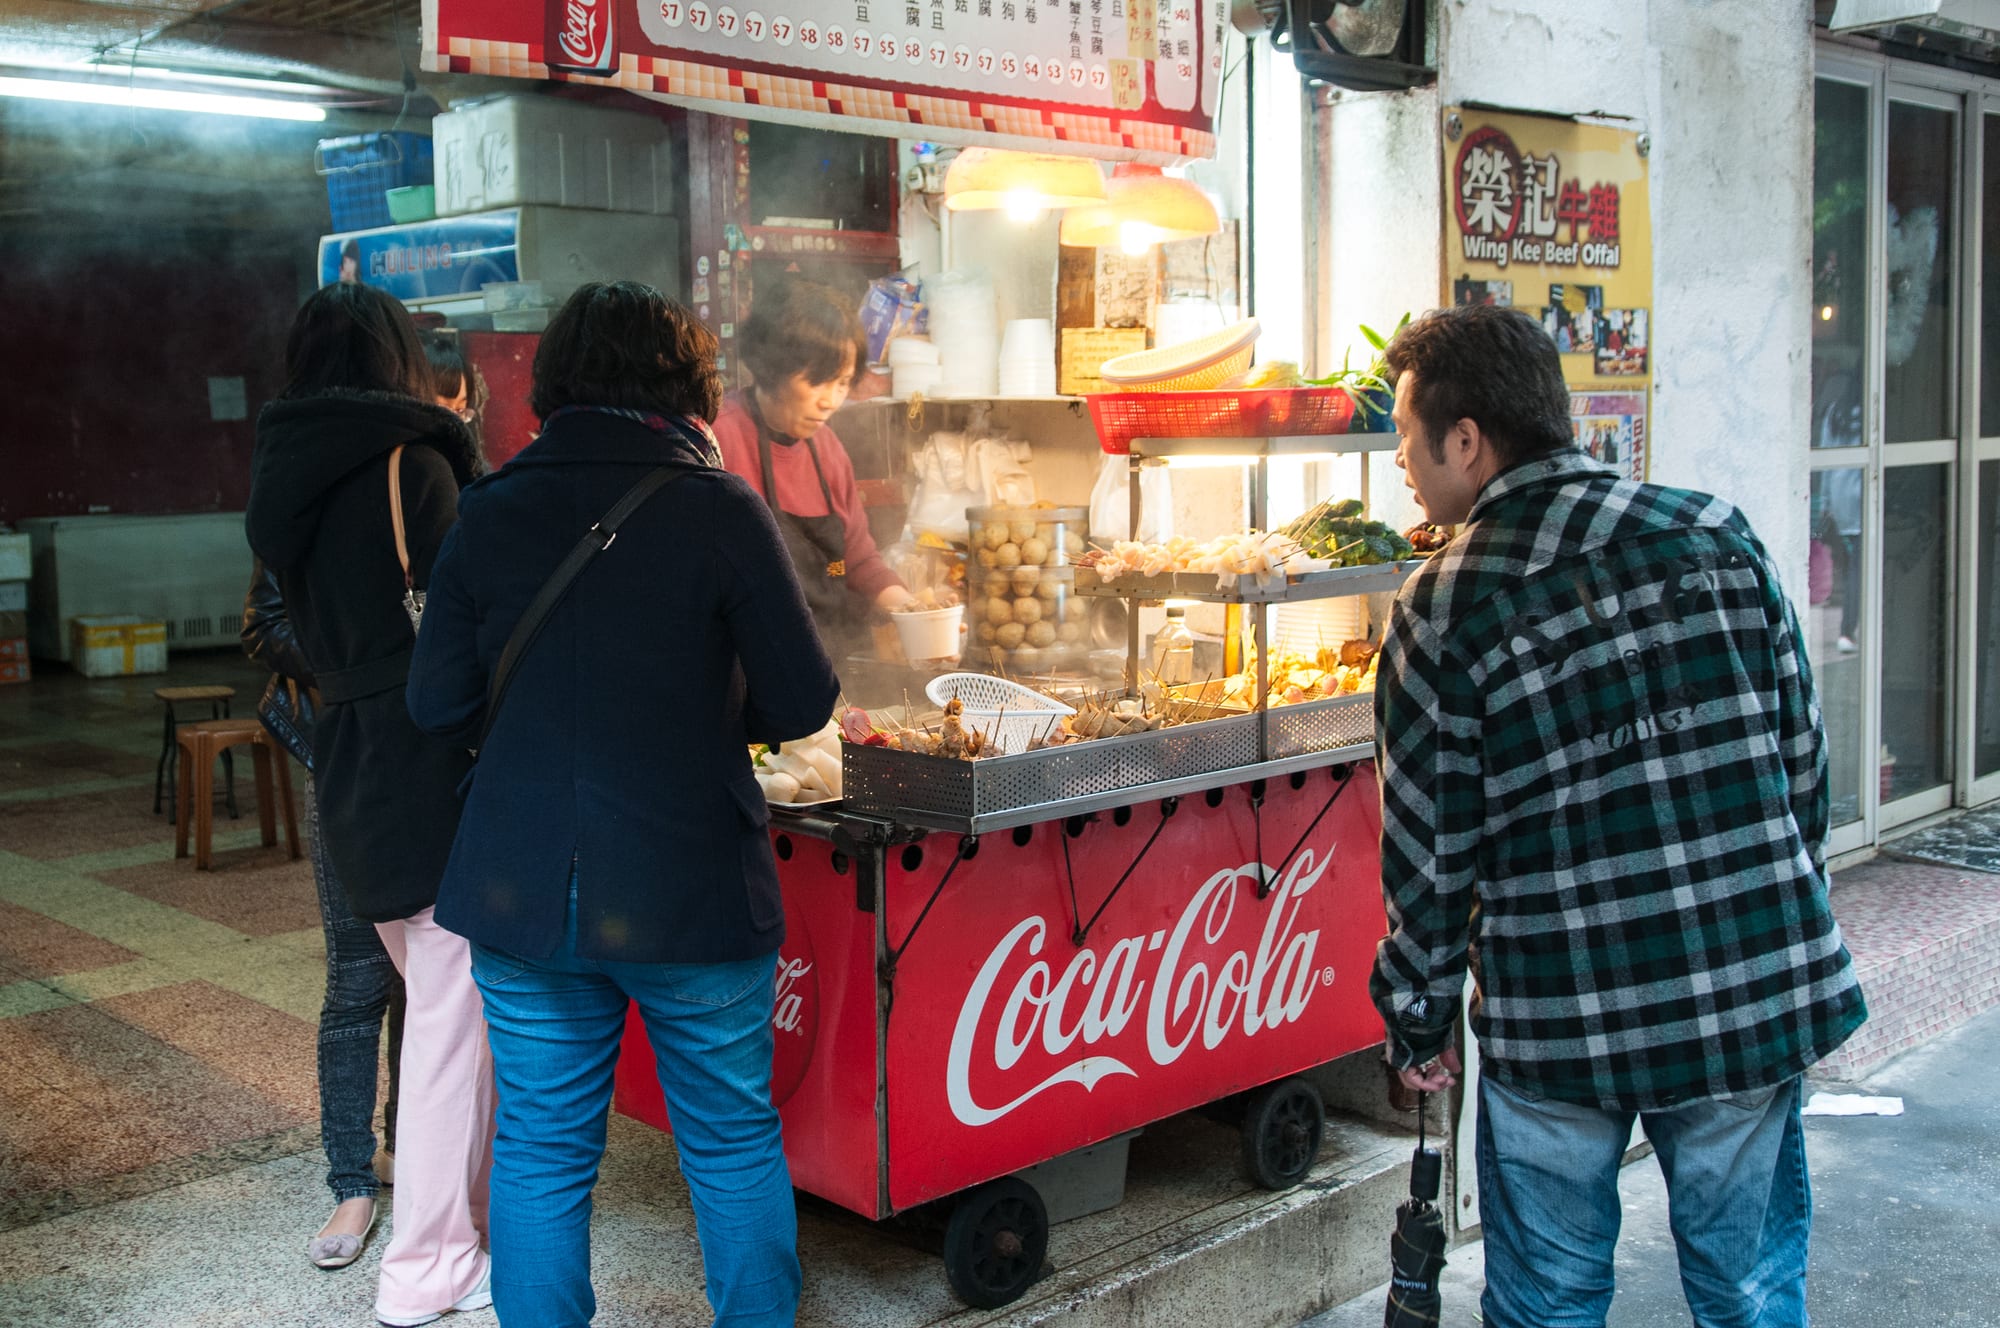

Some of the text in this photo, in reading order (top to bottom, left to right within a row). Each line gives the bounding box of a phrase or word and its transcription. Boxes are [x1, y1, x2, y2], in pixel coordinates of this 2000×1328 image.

[660, 3, 678, 20] $7
[689, 9, 706, 26] $7
[717, 13, 735, 31] $7
[745, 18, 762, 36] $7
[772, 23, 790, 40] $7
[800, 28, 817, 44] $8
[827, 32, 843, 47] $8
[853, 36, 870, 53] $7
[879, 41, 895, 56] $5
[905, 44, 920, 58] $8
[929, 48, 946, 64] $7
[954, 52, 969, 67] $7
[978, 55, 993, 71] $7
[1001, 58, 1016, 74] $5
[1024, 62, 1039, 77] $4
[1047, 65, 1061, 79] $3
[1069, 68, 1084, 83] $7
[1091, 71, 1106, 85] $7
[1463, 235, 1621, 267] Wing Kee Beef Offal
[946, 842, 1336, 1127] Coca-Cola
